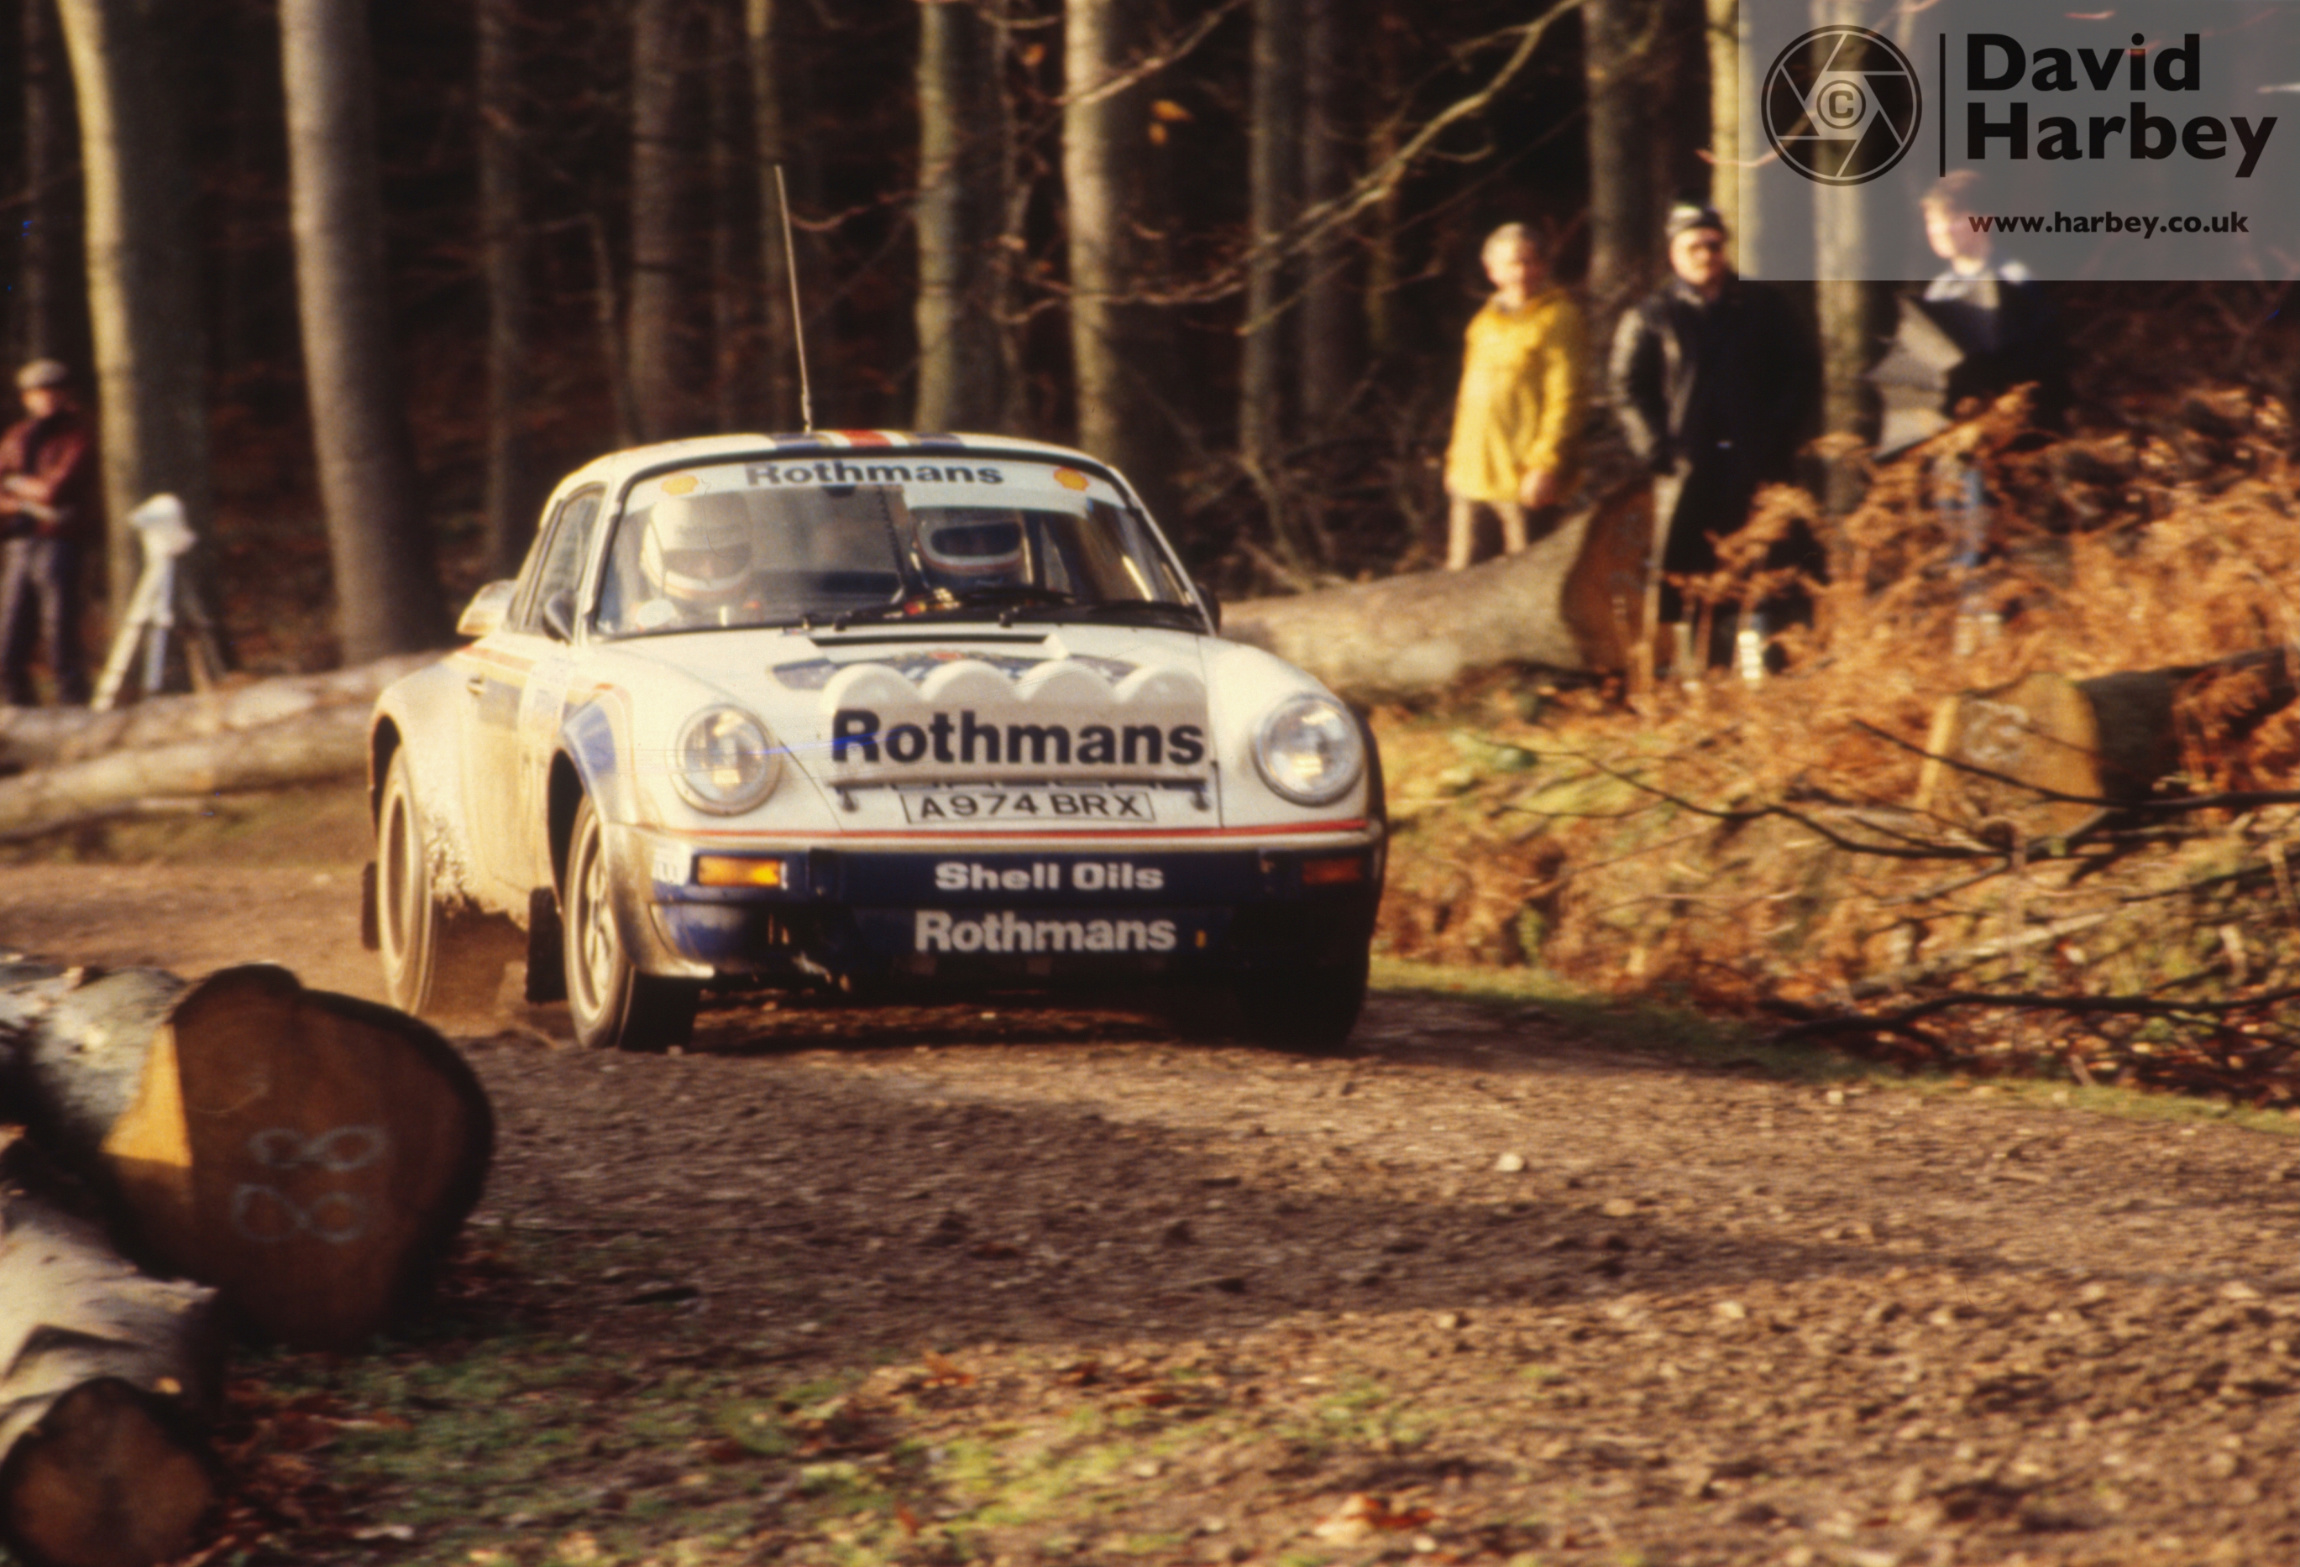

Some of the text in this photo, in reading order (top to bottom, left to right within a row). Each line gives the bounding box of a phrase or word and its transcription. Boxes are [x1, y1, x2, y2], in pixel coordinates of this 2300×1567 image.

[745, 459, 1004, 486] Rothmans
[831, 709, 1205, 765] Rothmans
[919, 792, 1143, 820] A974 BRX
[934, 862, 1165, 891] Shell Oils
[914, 910, 1177, 952] Rothmans
